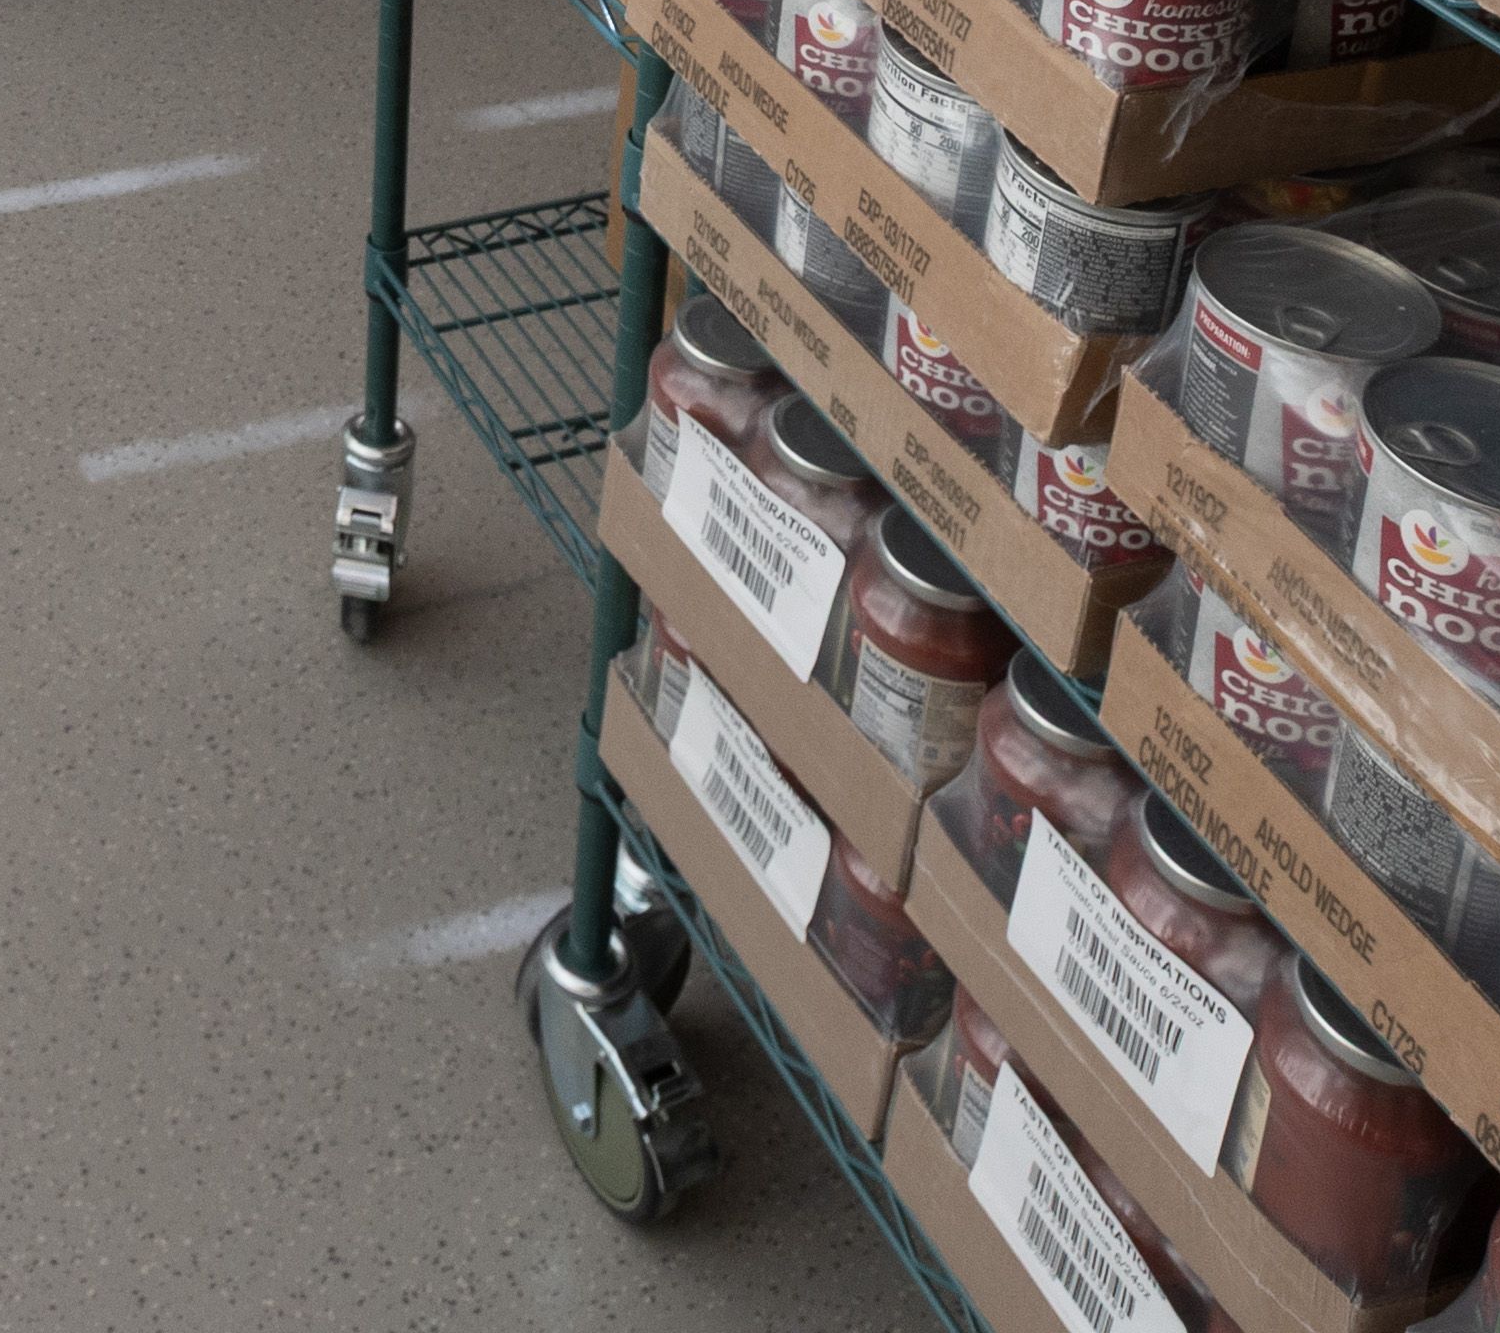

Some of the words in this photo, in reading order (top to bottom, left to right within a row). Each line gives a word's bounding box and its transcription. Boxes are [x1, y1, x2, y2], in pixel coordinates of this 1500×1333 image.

[650, 25, 689, 87] CHICKEN
[689, 60, 729, 118] NOODLE
[718, 51, 754, 101] AHOLD
[753, 85, 789, 134] WEDGE
[921, 83, 968, 114] Facts
[785, 157, 817, 207] C1725
[938, 135, 962, 153] 200
[692, 209, 729, 263] 12/19OZ
[857, 187, 885, 232] EXP:
[884, 212, 932, 277] 03/17/27
[685, 233, 728, 306] CHICKEN
[726, 279, 770, 342] NOODLE
[792, 313, 832, 368] WEDGE
[688, 421, 725, 464] TASTE
[725, 460, 740, 480] OF
[740, 475, 829, 559] INSPIRATIONS
[1138, 735, 1204, 840] CHICKEN
[1203, 813, 1273, 907] NOODLE
[1151, 704, 1214, 786] 12/19OZ
[1254, 816, 1316, 910] AHOLD
[1310, 882, 1377, 967] WEDGE
[1047, 829, 1088, 879] TASTE
[1091, 883, 1109, 905] OF
[1112, 907, 1227, 1024] INSPIRATIONS
[1057, 867, 1093, 914] Tomato
[1120, 942, 1157, 986] Sauce
[1159, 982, 1204, 1027] 6/24oz
[1370, 998, 1428, 1082] C1725
[1011, 1083, 1052, 1137] TASTE
[1052, 1134, 1073, 1164] OF
